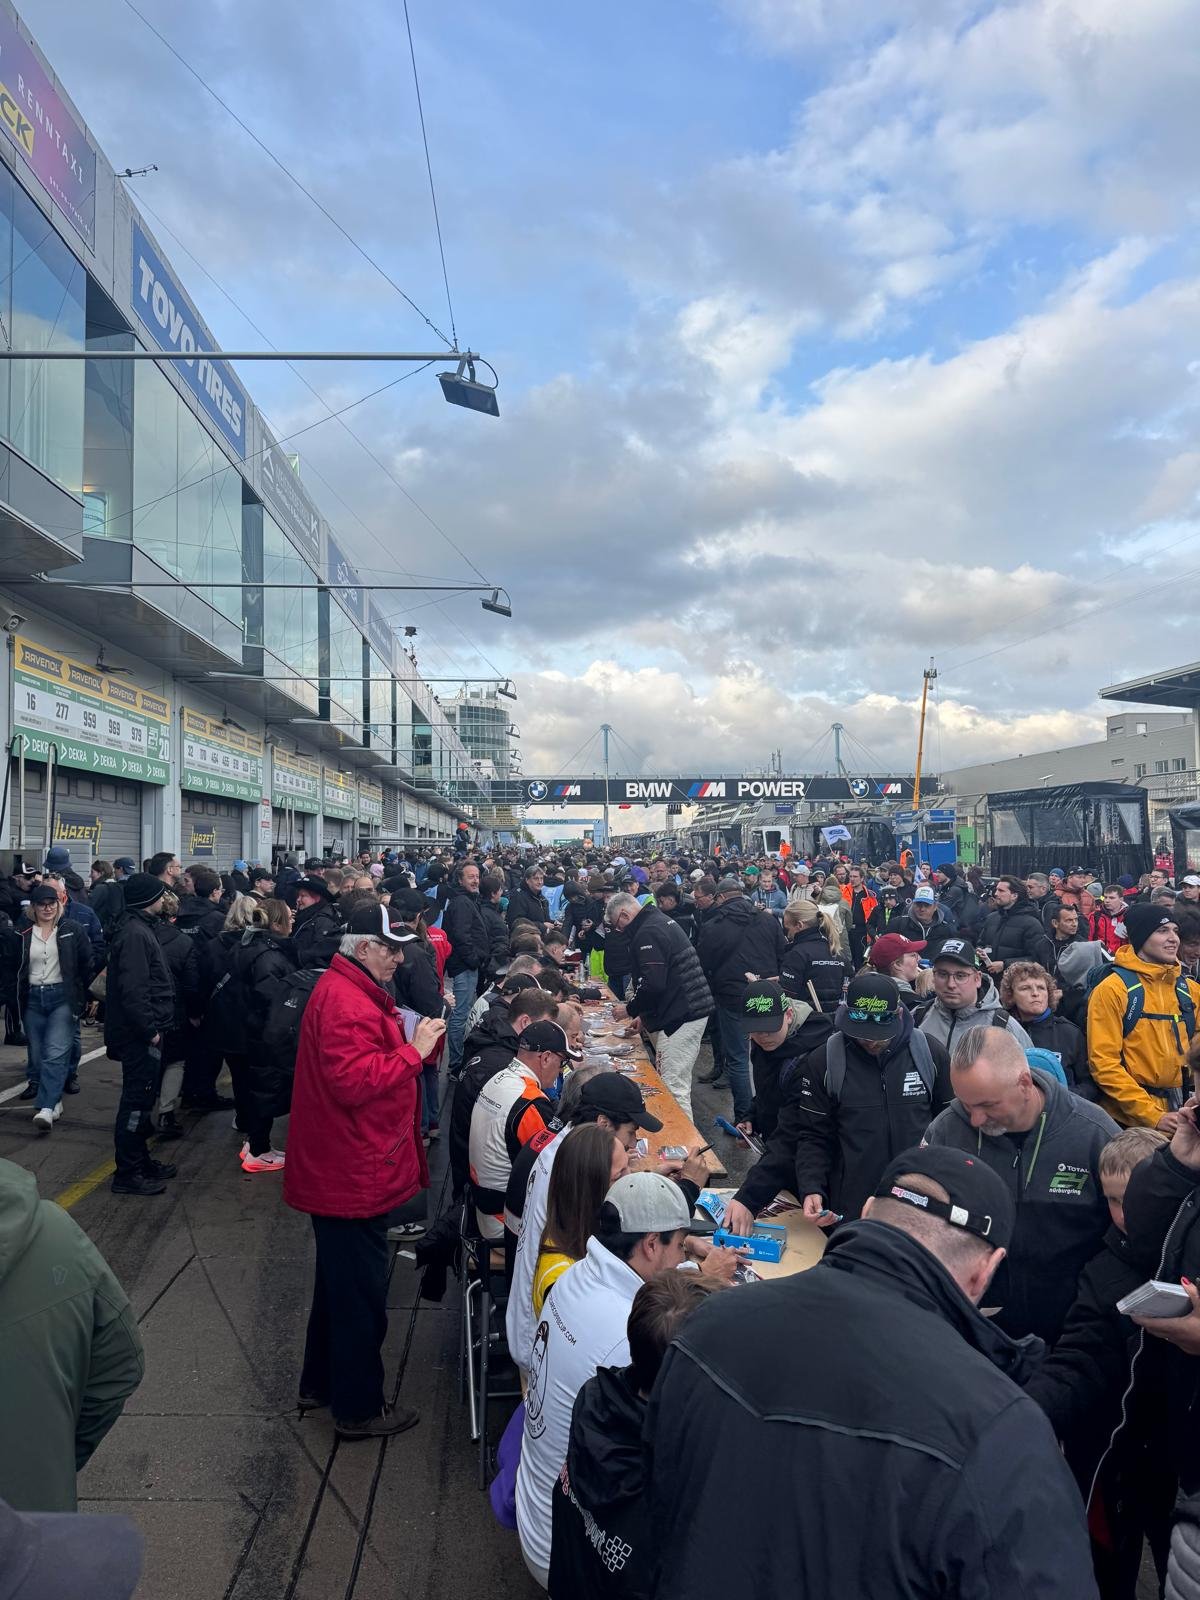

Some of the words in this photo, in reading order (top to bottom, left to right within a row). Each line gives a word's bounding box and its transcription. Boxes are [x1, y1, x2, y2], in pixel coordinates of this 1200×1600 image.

[18, 73, 83, 184] RENNTAXI
[139, 255, 194, 366] TOYO
[198, 345, 242, 437] TIRES
[24, 651, 60, 673] RAVENOL
[71, 670, 101, 689] RAVENOL
[110, 685, 135, 702] RAVENOL
[143, 698, 166, 714] RAVENOL
[26, 692, 36, 710] 16
[55, 702, 69, 720] 277
[83, 710, 97, 729] 959
[108, 719, 121, 736] 969
[131, 726, 142, 742] 979
[31, 738, 50, 755] DEKR
[68, 747, 88, 763] DEKRA
[100, 755, 117, 769] DEKRA
[128, 761, 143, 774] DEKRA
[152, 767, 166, 778] DEKRA
[159, 737, 170, 760] 20
[625, 782, 673, 798] BMW
[737, 782, 805, 797] POWER
[60, 823, 98, 841] HAZET
[194, 832, 214, 844] HAZET
[1066, 1165, 1090, 1173] TOTAL
[1049, 1187, 1081, 1196] nürburgring
